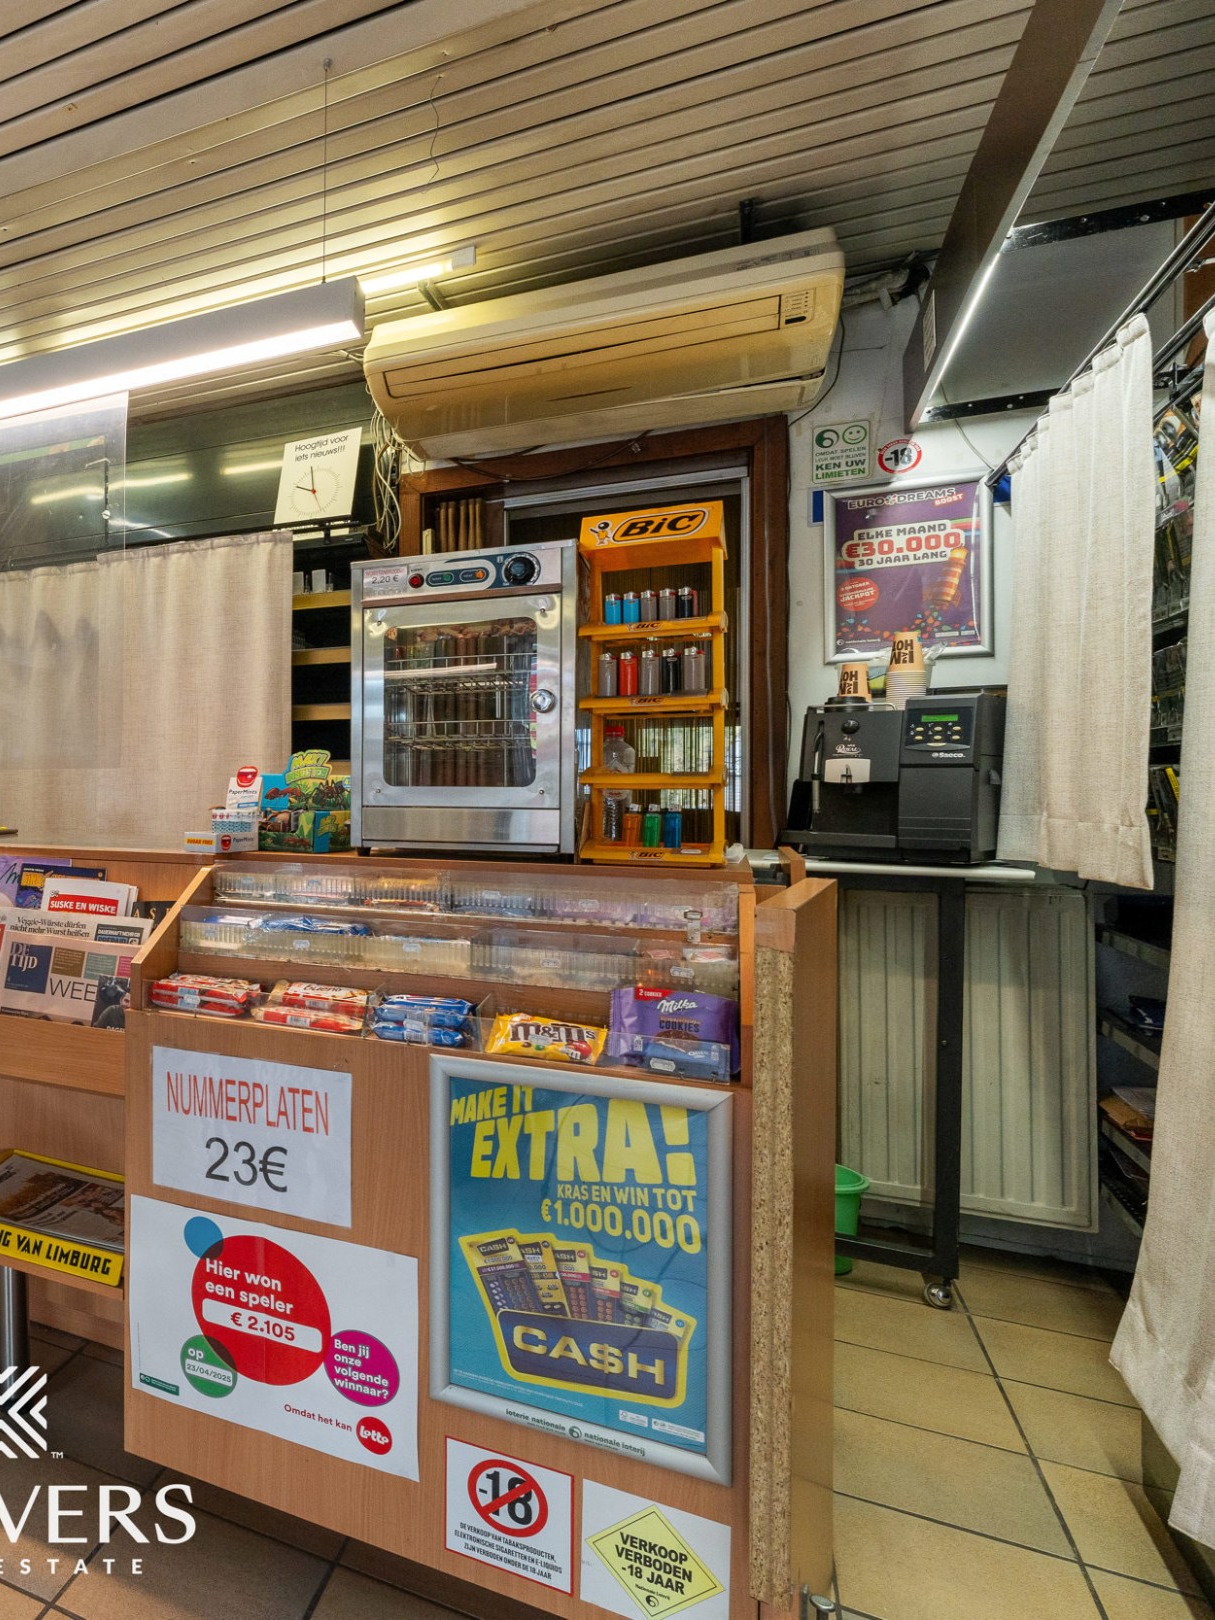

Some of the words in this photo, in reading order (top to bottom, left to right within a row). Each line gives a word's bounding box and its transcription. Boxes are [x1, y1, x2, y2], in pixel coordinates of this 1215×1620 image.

[294, 438, 329, 452] Hoogtijd
[331, 434, 349, 445] voor
[841, 446, 867, 454] SPELEN
[294, 453, 309, 462] iets
[815, 461, 842, 471] KEN
[845, 458, 866, 468] UW
[815, 467, 866, 480] LIMIETEN
[848, 499, 884, 510] EURO
[897, 487, 956, 504] DREAMS
[934, 493, 964, 506] BOOST
[858, 528, 893, 541] ELKE
[897, 523, 947, 536] MAAND
[845, 531, 961, 559] €30.000
[858, 558, 873, 567] 30
[877, 555, 910, 566] JAAR
[913, 550, 947, 561] LANG
[372, 574, 391, 585] 2,20
[392, 574, 399, 583] €
[840, 590, 875, 602] JACKPOT
[50, 900, 74, 910] SUSKE
[75, 901, 86, 910] EN
[88, 903, 116, 914] WISKE
[13, 942, 30, 955] DE
[10, 954, 38, 972] TIJD
[303, 982, 342, 993] bueno
[657, 998, 698, 1013] Milka
[659, 1019, 700, 1033] COOKIES
[167, 1071, 329, 1136] NUMMERPLATEN
[450, 1085, 508, 1127] MAKE
[513, 1084, 535, 1113] IT
[470, 1097, 698, 1187] EXTRA!
[205, 1137, 288, 1193] 23€
[557, 1183, 589, 1200] KRAS
[591, 1185, 611, 1203] EN
[614, 1186, 650, 1208] WIN
[652, 1189, 697, 1212] TOT
[16, 1234, 42, 1257] VAN
[46, 1243, 112, 1276] LIMBURG
[205, 1258, 240, 1281] Hier
[245, 1271, 282, 1292] won
[205, 1281, 235, 1300] een
[240, 1290, 293, 1315] speler
[231, 1312, 243, 1327] €
[247, 1316, 296, 1342] 2.105
[188, 1347, 204, 1362] op
[334, 1339, 356, 1354] Ben
[358, 1344, 370, 1359] jij
[334, 1353, 362, 1367] onze
[186, 1363, 232, 1384] 23/04/2025
[334, 1364, 389, 1387] volgende
[334, 1377, 389, 1399] winnaar?
[284, 1404, 316, 1422] Omdat
[317, 1411, 333, 1424] het
[335, 1418, 352, 1432] kan
[506, 1408, 530, 1421] loterie
[532, 1415, 566, 1432] nationale
[359, 1425, 389, 1445] Lotto
[584, 1432, 620, 1448] nationale
[622, 1442, 645, 1457] loterij
[478, 1470, 534, 1526] -18
[460, 1522, 467, 1530] DE
[467, 1524, 491, 1537] VERKOOP
[491, 1533, 502, 1541] VAN
[455, 1529, 495, 1550] ELEKTRONISCHE
[495, 1543, 527, 1561] SIGARETTEN
[527, 1555, 535, 1564] EN
[535, 1557, 562, 1574] E-LIQUIDS
[619, 1532, 688, 1563] VERKOOP
[464, 1542, 476, 1552] ZIJN
[476, 1546, 503, 1562] VERBODEN
[504, 1556, 522, 1568] ONDER
[522, 1563, 529, 1572] DE
[529, 1566, 536, 1574] 18
[536, 1568, 552, 1580] JAAR
[614, 1545, 693, 1582] VERBODEN
[621, 1564, 643, 1579] -18
[647, 1570, 685, 1595] JAAR
